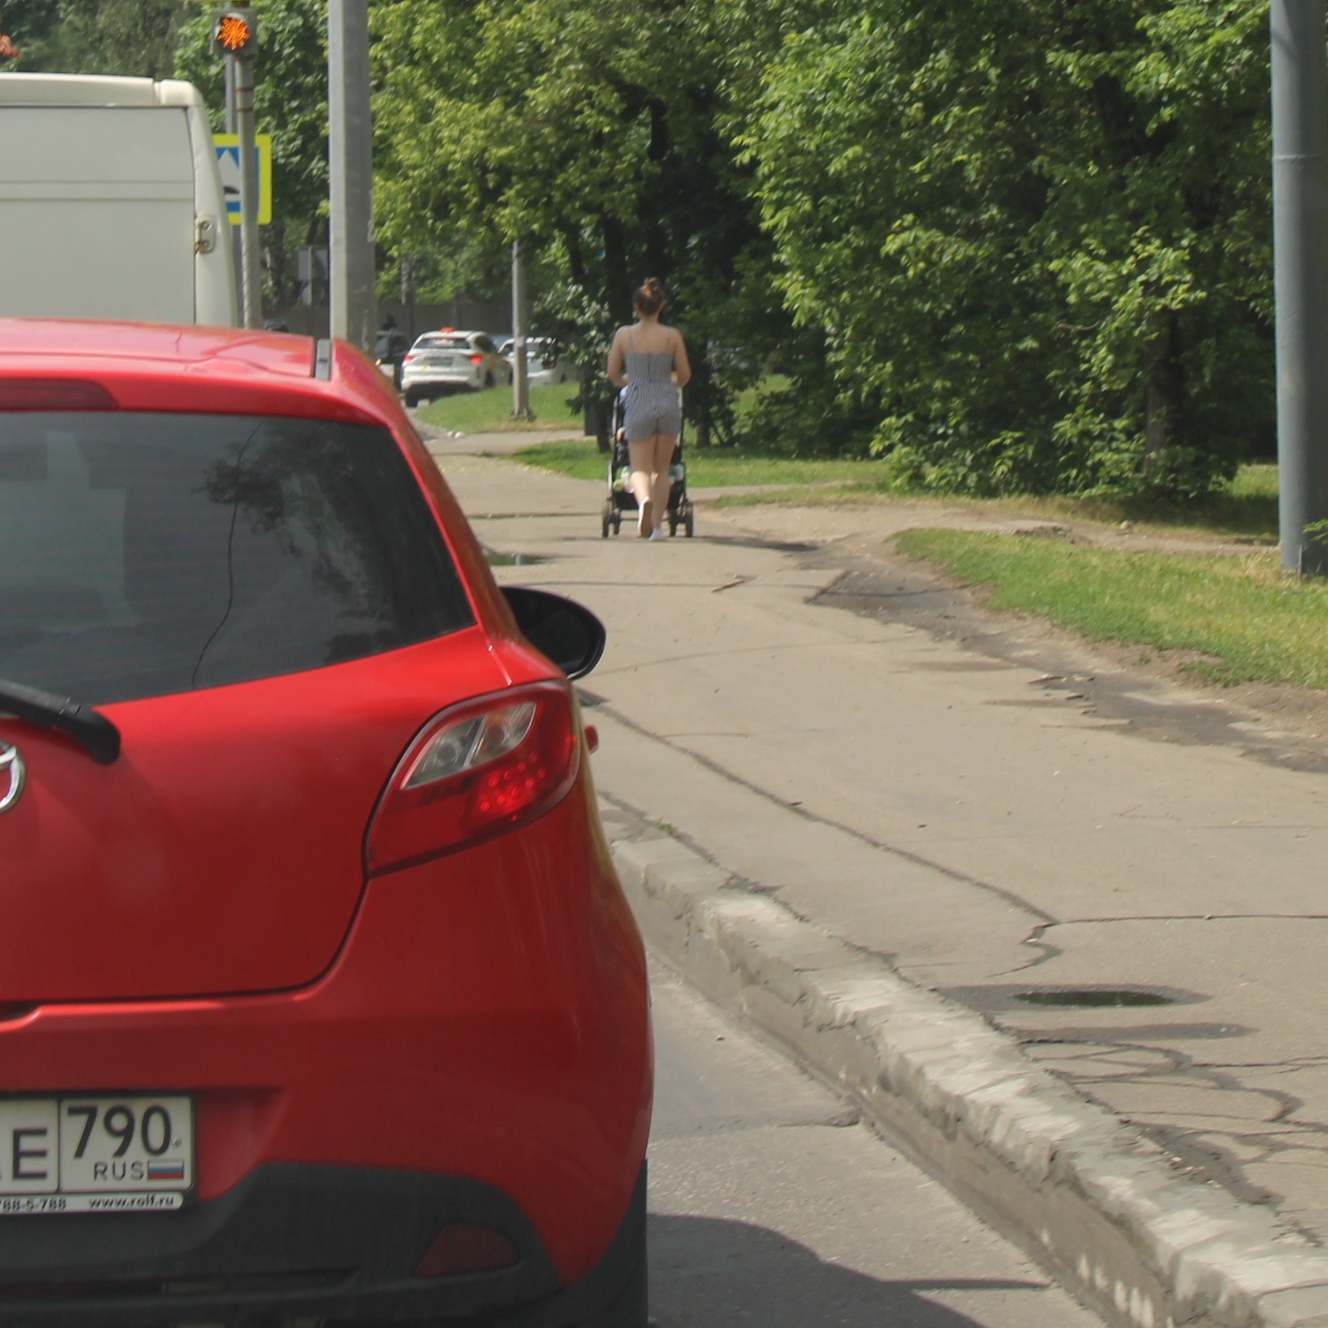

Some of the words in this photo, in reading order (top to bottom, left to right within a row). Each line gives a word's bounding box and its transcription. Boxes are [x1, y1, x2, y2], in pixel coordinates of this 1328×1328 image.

[67, 1105, 172, 1159] 790
[93, 1162, 145, 1181] RUS
[88, 1193, 174, 1210] www.rolf.ru
